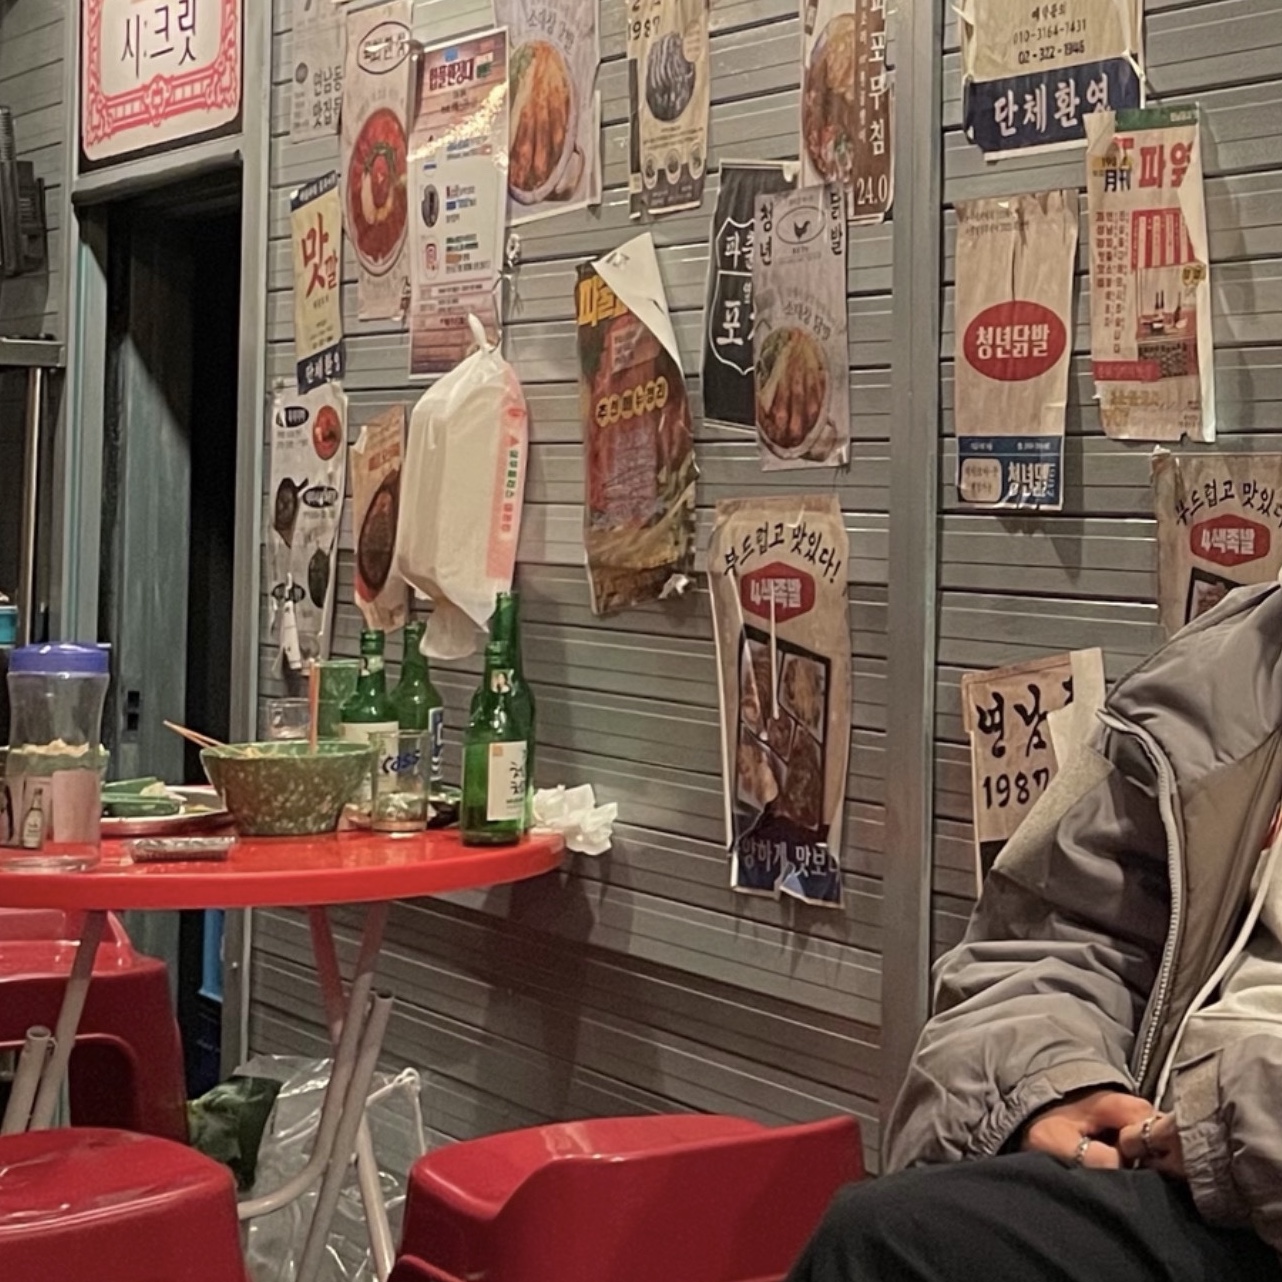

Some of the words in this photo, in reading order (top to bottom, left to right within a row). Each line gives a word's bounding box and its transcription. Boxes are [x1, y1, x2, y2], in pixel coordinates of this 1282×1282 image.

[976, 324, 1050, 361] 청년닭발
[1174, 477, 1236, 527] 부드럽고
[723, 520, 785, 577] 부드럽고
[790, 520, 842, 584] 맛있다!
[982, 766, 1050, 810] 1987
